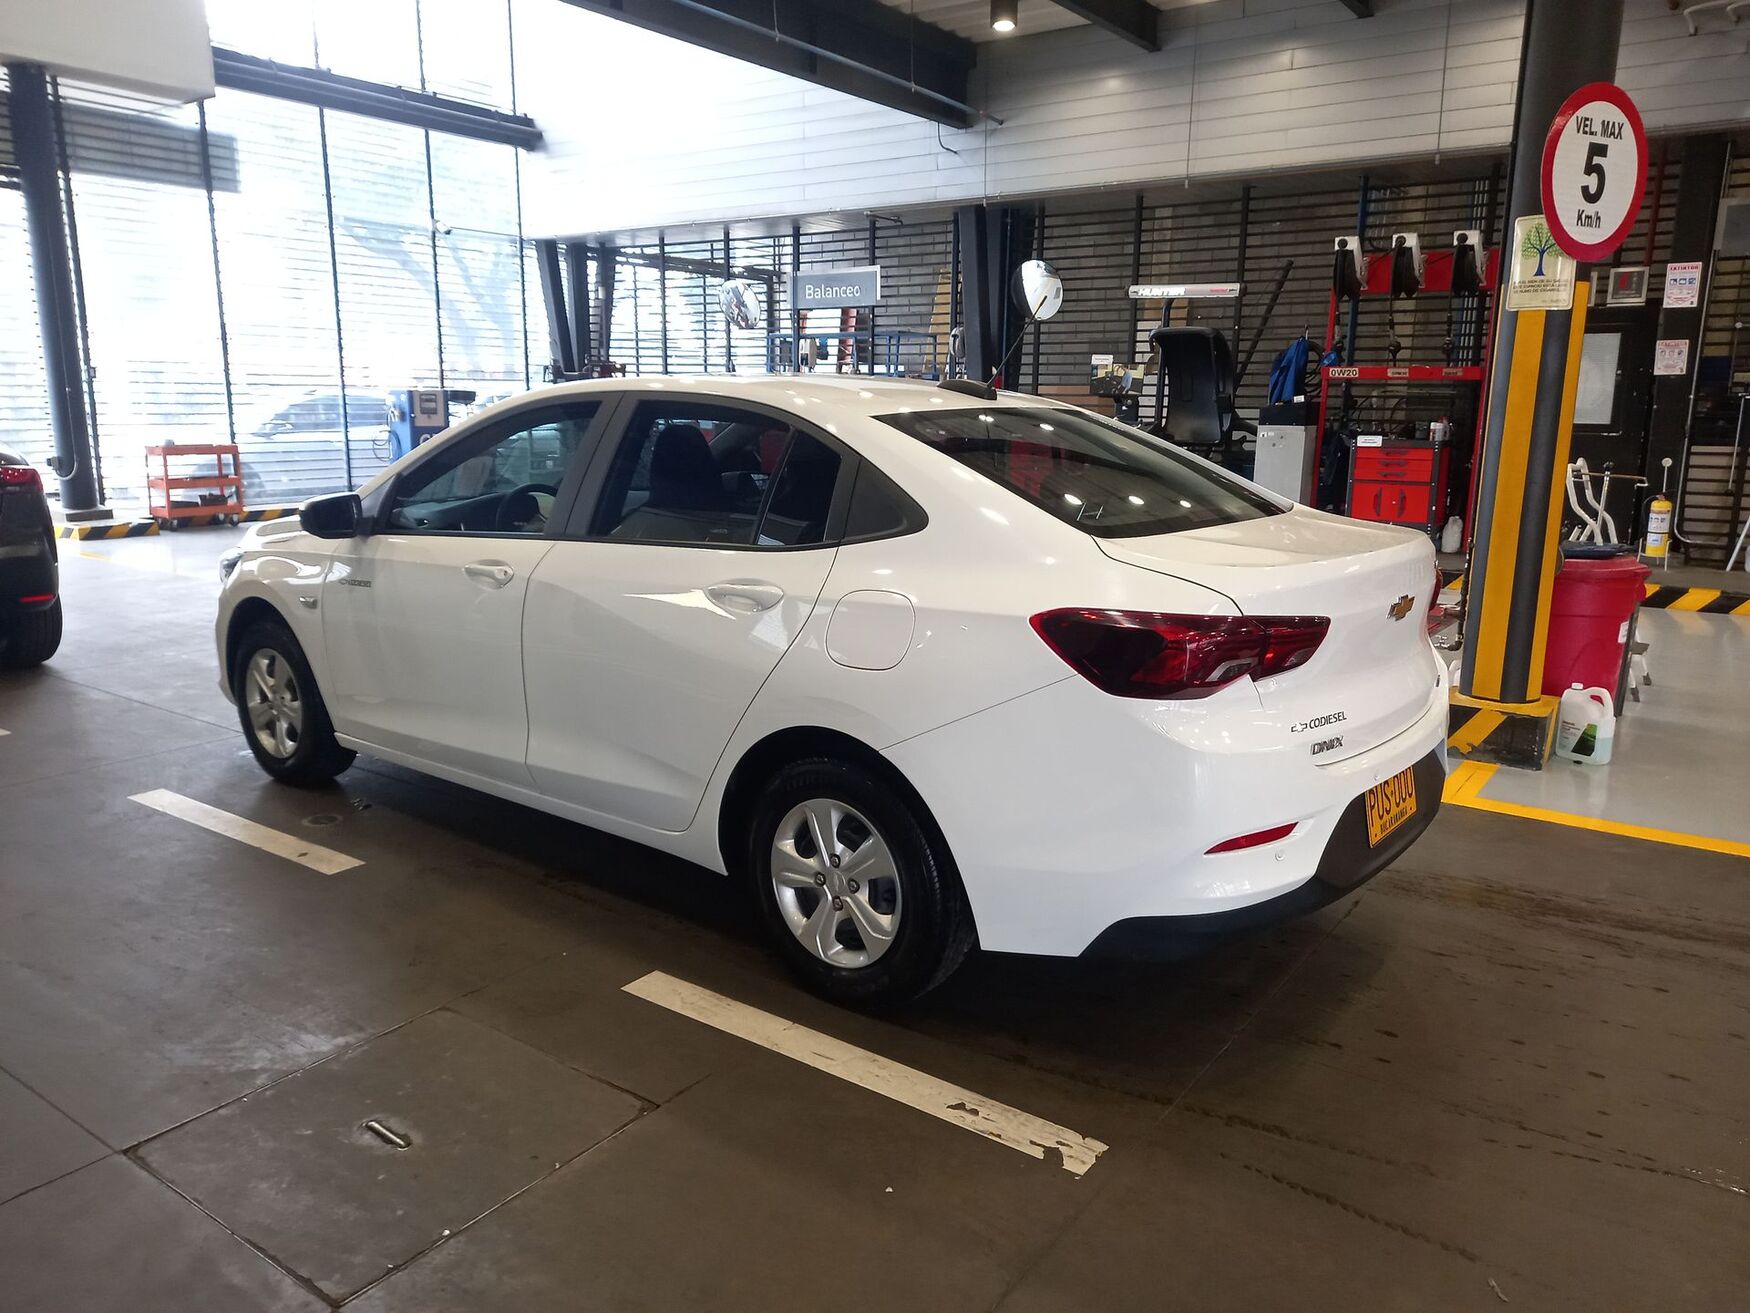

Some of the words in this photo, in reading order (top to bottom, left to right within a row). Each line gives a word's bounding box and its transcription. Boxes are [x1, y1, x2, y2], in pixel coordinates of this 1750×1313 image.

[1576, 115, 1598, 136] VEL.
[1600, 119, 1624, 140] MAX
[1581, 141, 1608, 204] 5
[1576, 209, 1601, 228] Km/h
[805, 284, 861, 299] Balanceo
[1308, 711, 1347, 730] CODIESEL
